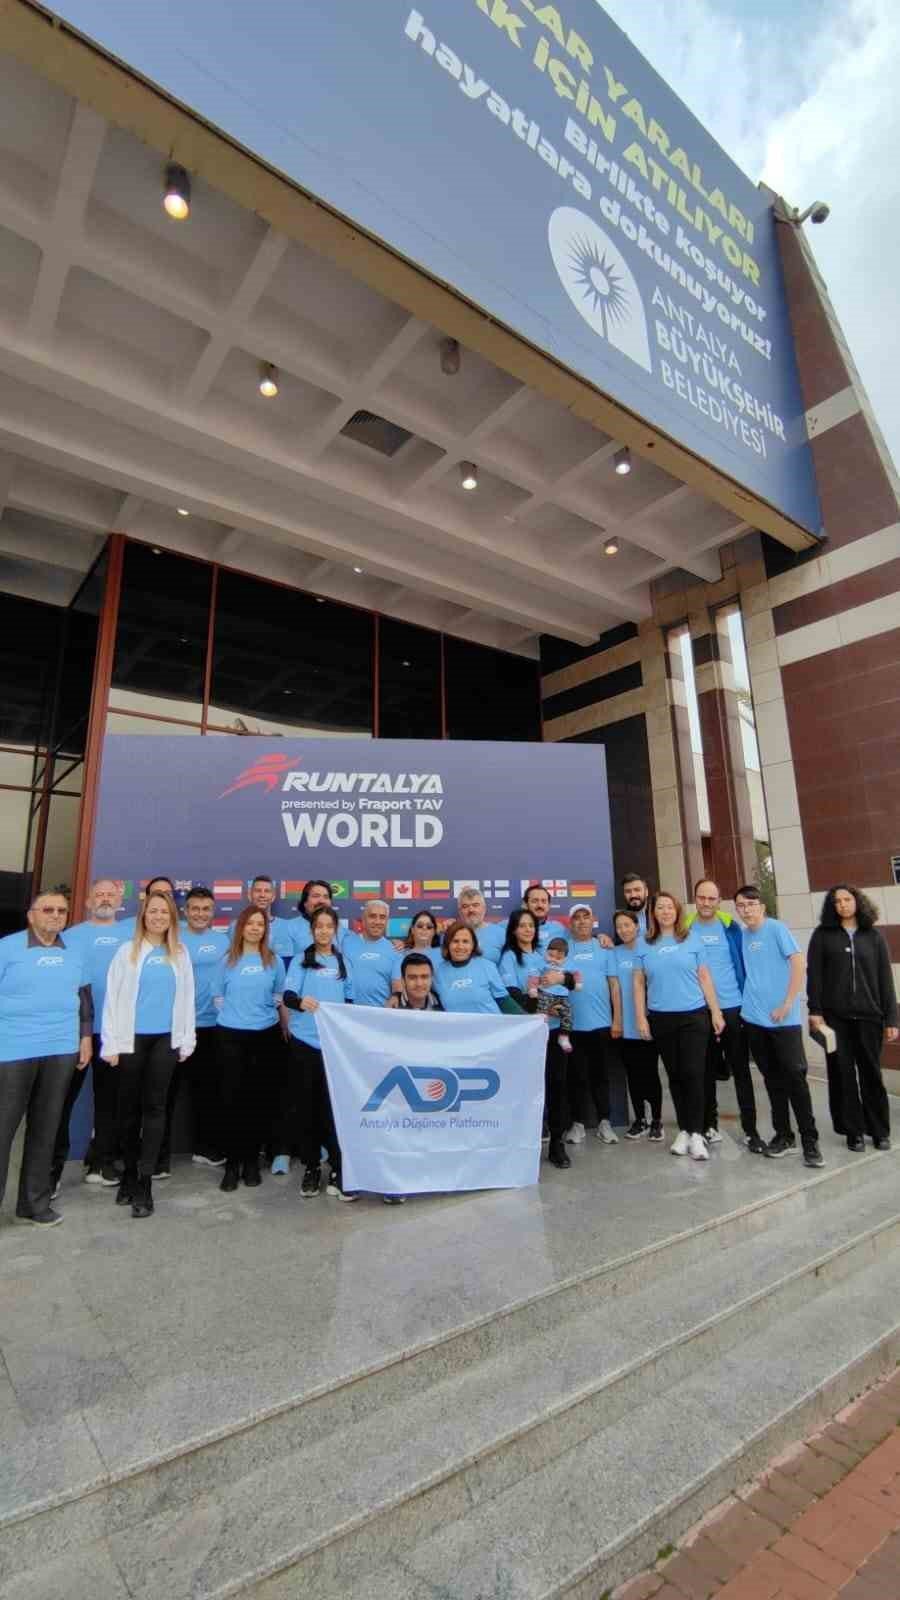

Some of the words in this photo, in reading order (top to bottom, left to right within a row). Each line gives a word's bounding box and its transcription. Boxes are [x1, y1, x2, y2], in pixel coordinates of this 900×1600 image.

[405, 8, 592, 200] hayatlara
[534, 35, 617, 143] İÇİN
[623, 141, 760, 287] ATILIYOR
[603, 65, 754, 245] YARALARI
[564, 117, 671, 235] Birlikte
[675, 225, 767, 322] koşuyor
[652, 286, 742, 376] ANTALYA
[655, 320, 786, 443] BÜYÜKŞEHİR
[661, 360, 767, 459] BELEDİYESİ
[281, 771, 444, 794] RUNTALYA
[281, 800, 339, 810] presented
[342, 800, 356, 811] by
[359, 798, 412, 812] Fraport
[414, 799, 444, 810] TAV
[281, 812, 444, 848] WORLD
[360, 1117, 399, 1132] Antalya
[402, 1117, 447, 1132] Düşünce
[449, 1117, 500, 1129] Platformu
[361, 1065, 500, 1112] ADP
